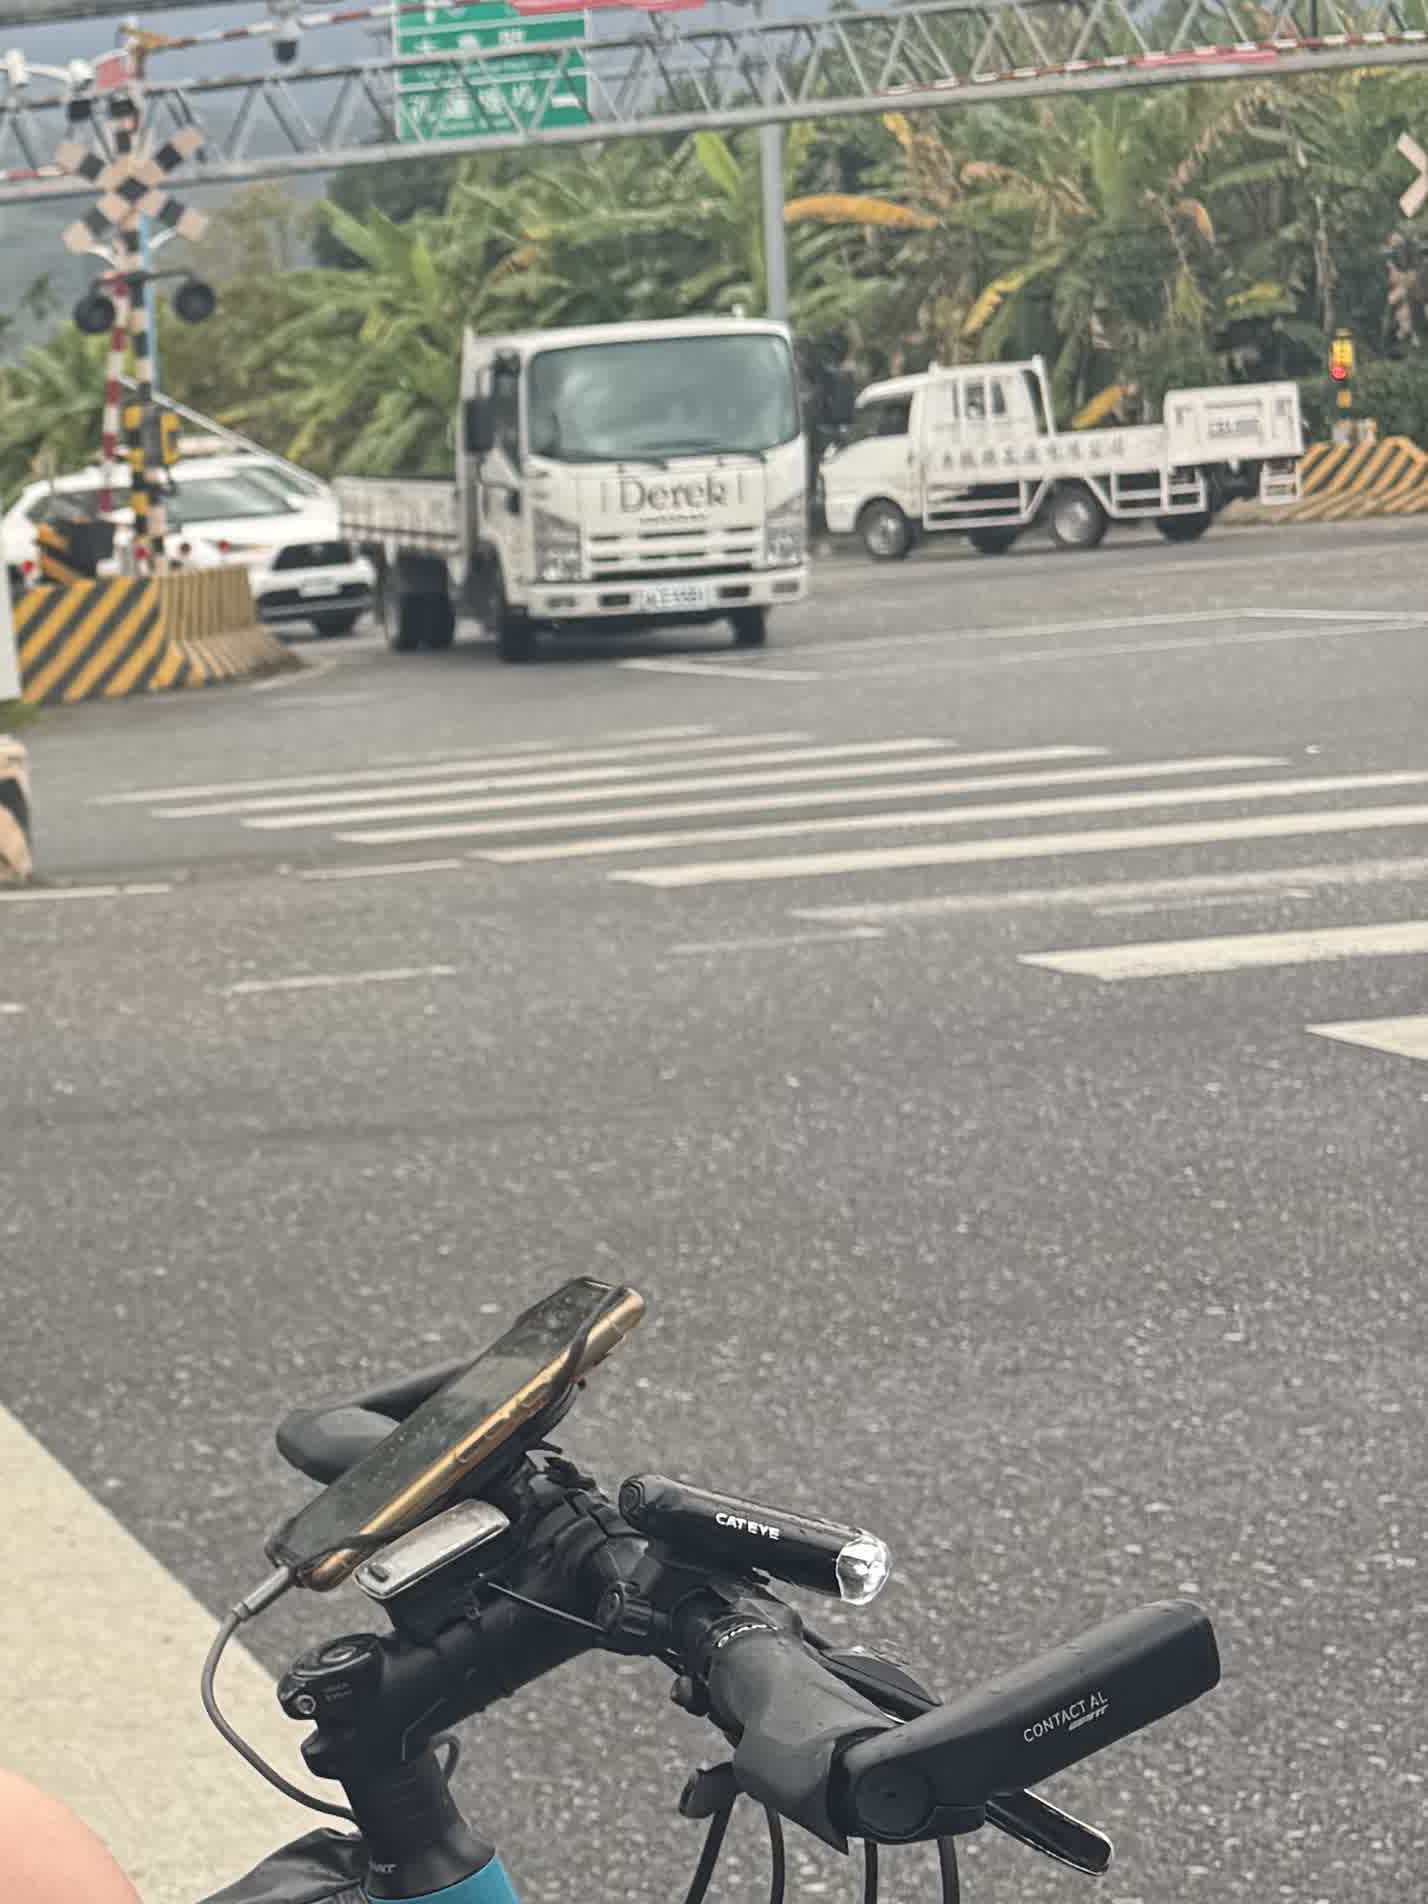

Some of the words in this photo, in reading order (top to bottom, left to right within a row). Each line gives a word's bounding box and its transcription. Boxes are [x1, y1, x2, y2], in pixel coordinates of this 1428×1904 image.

[618, 473, 729, 513] Derek
[1023, 1700, 1086, 1743] CONTACT
[1090, 1691, 1108, 1710] AL
